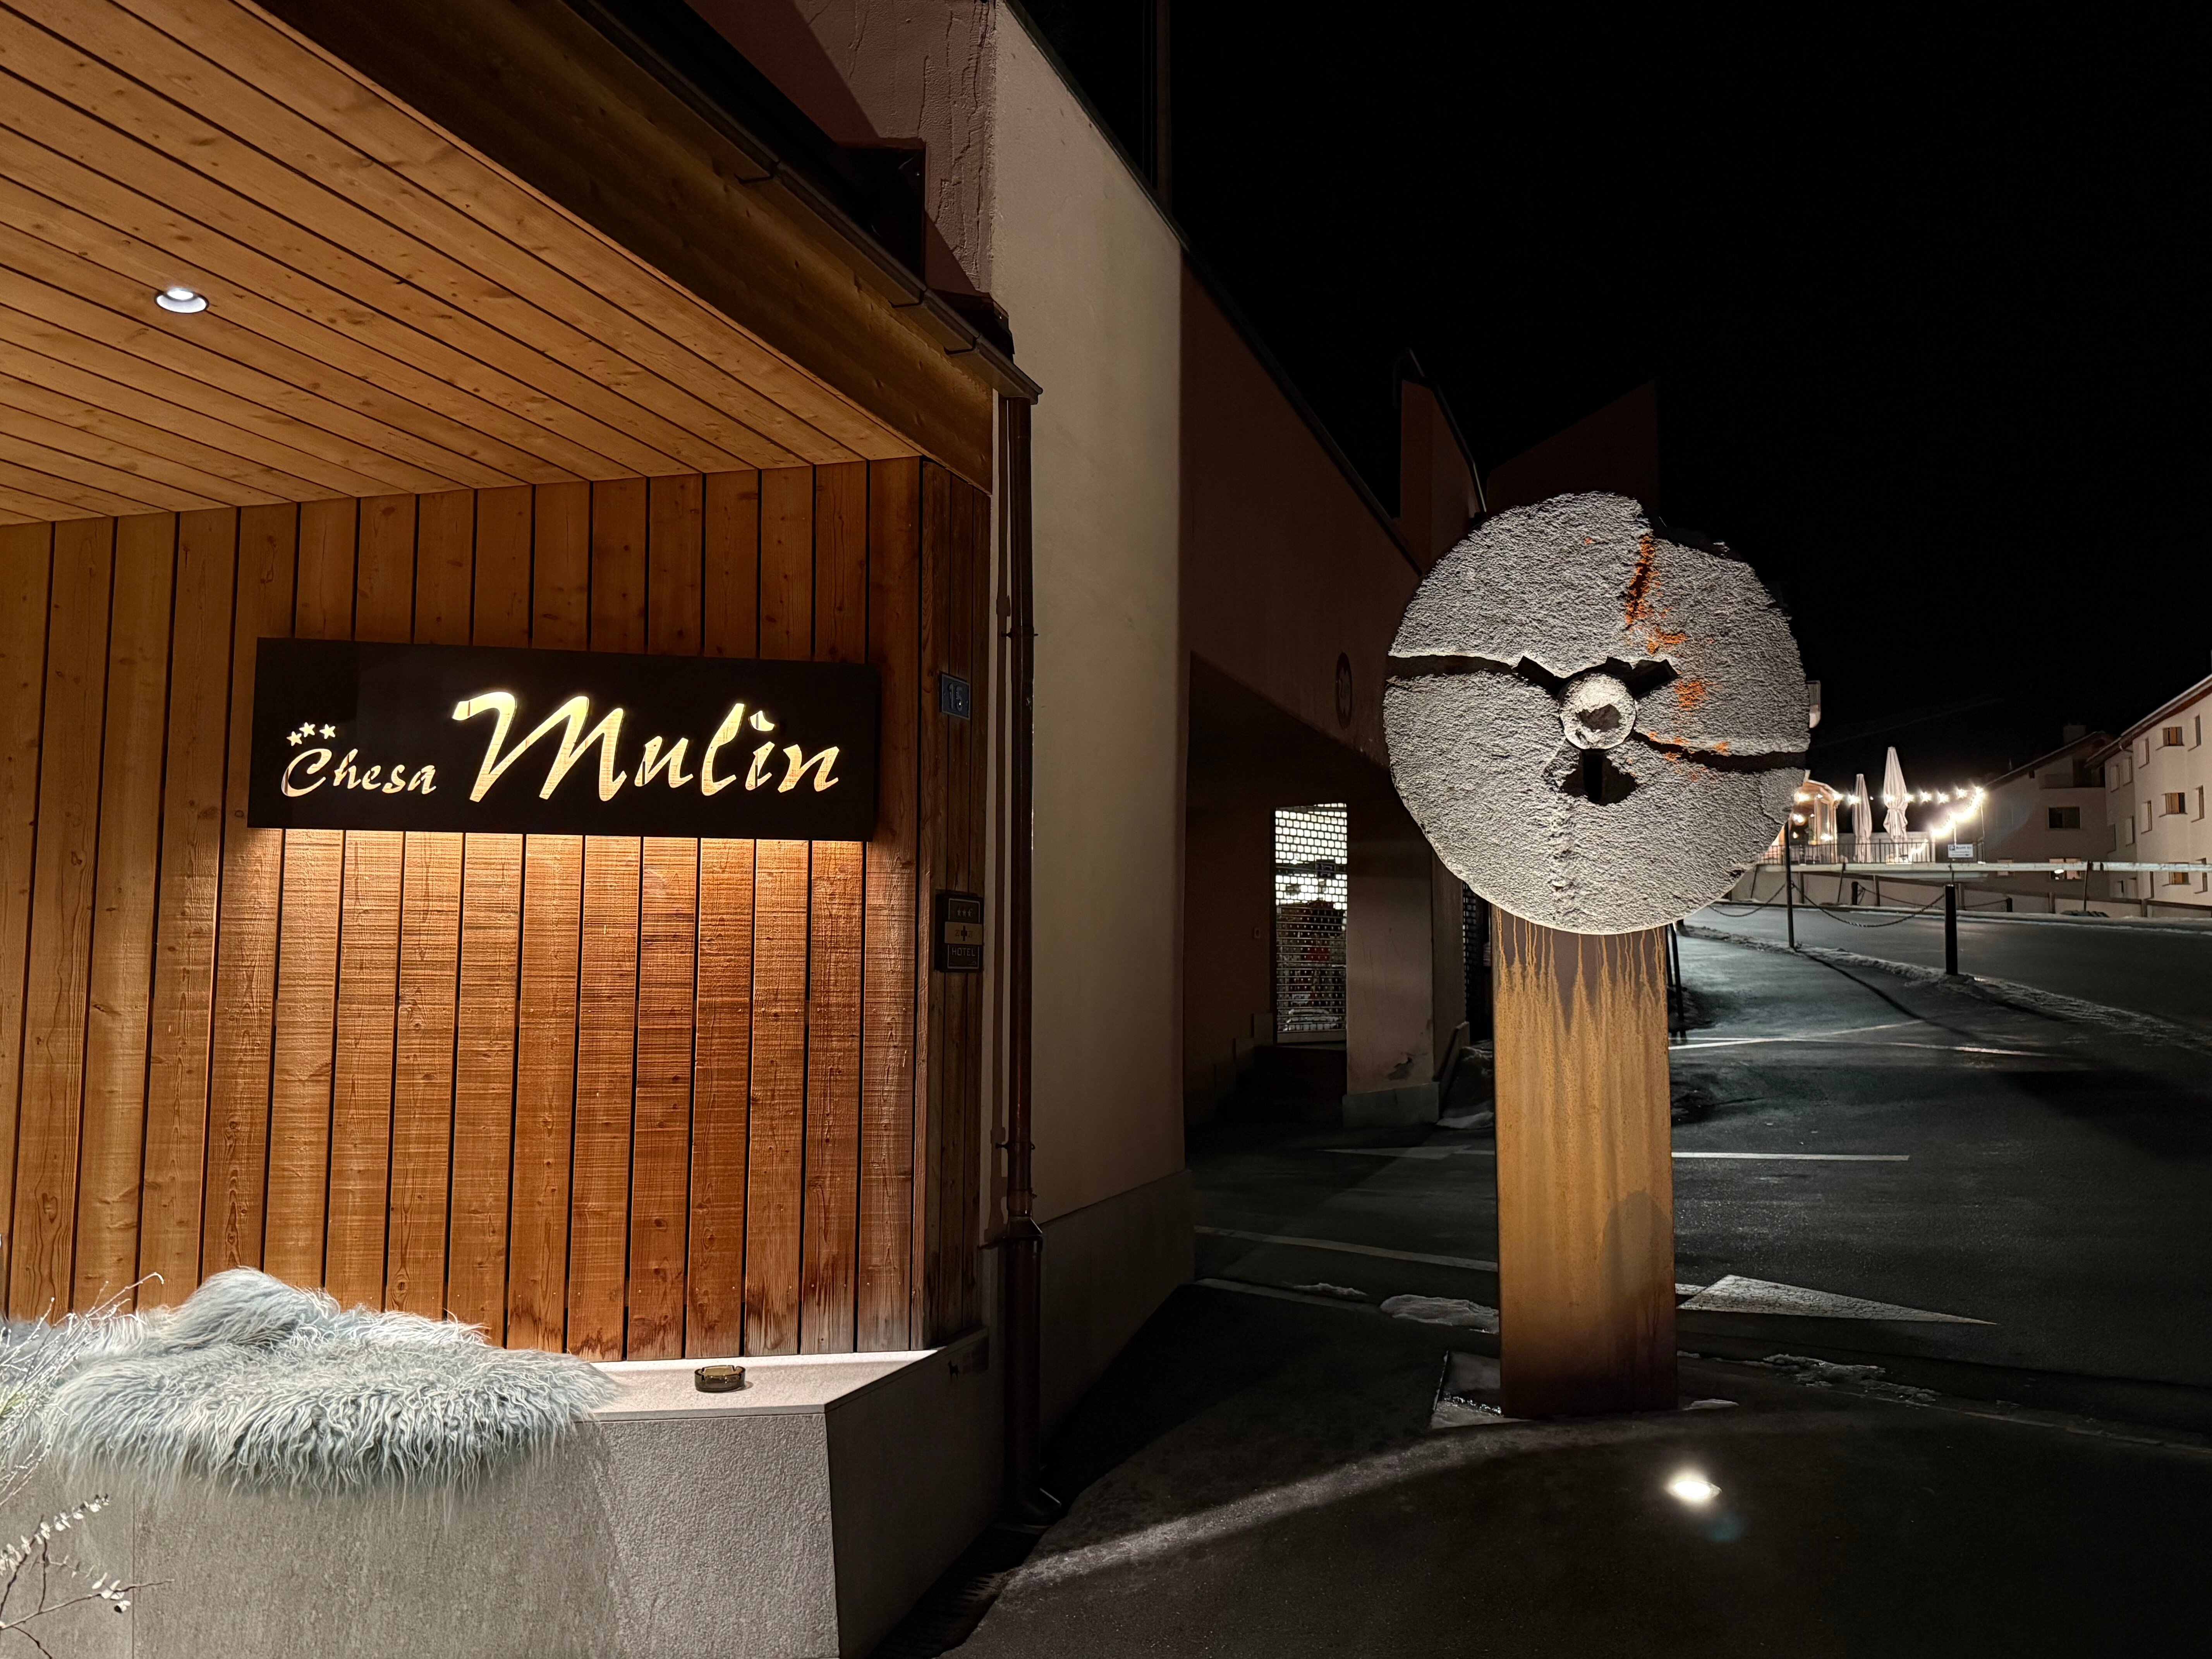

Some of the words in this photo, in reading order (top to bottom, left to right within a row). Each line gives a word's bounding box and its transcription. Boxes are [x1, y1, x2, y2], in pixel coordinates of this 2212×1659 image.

[949, 684, 963, 712] 15
[281, 748, 437, 797] Chesa
[452, 690, 840, 803] Mulin
[952, 947, 975, 956] HOTEL
